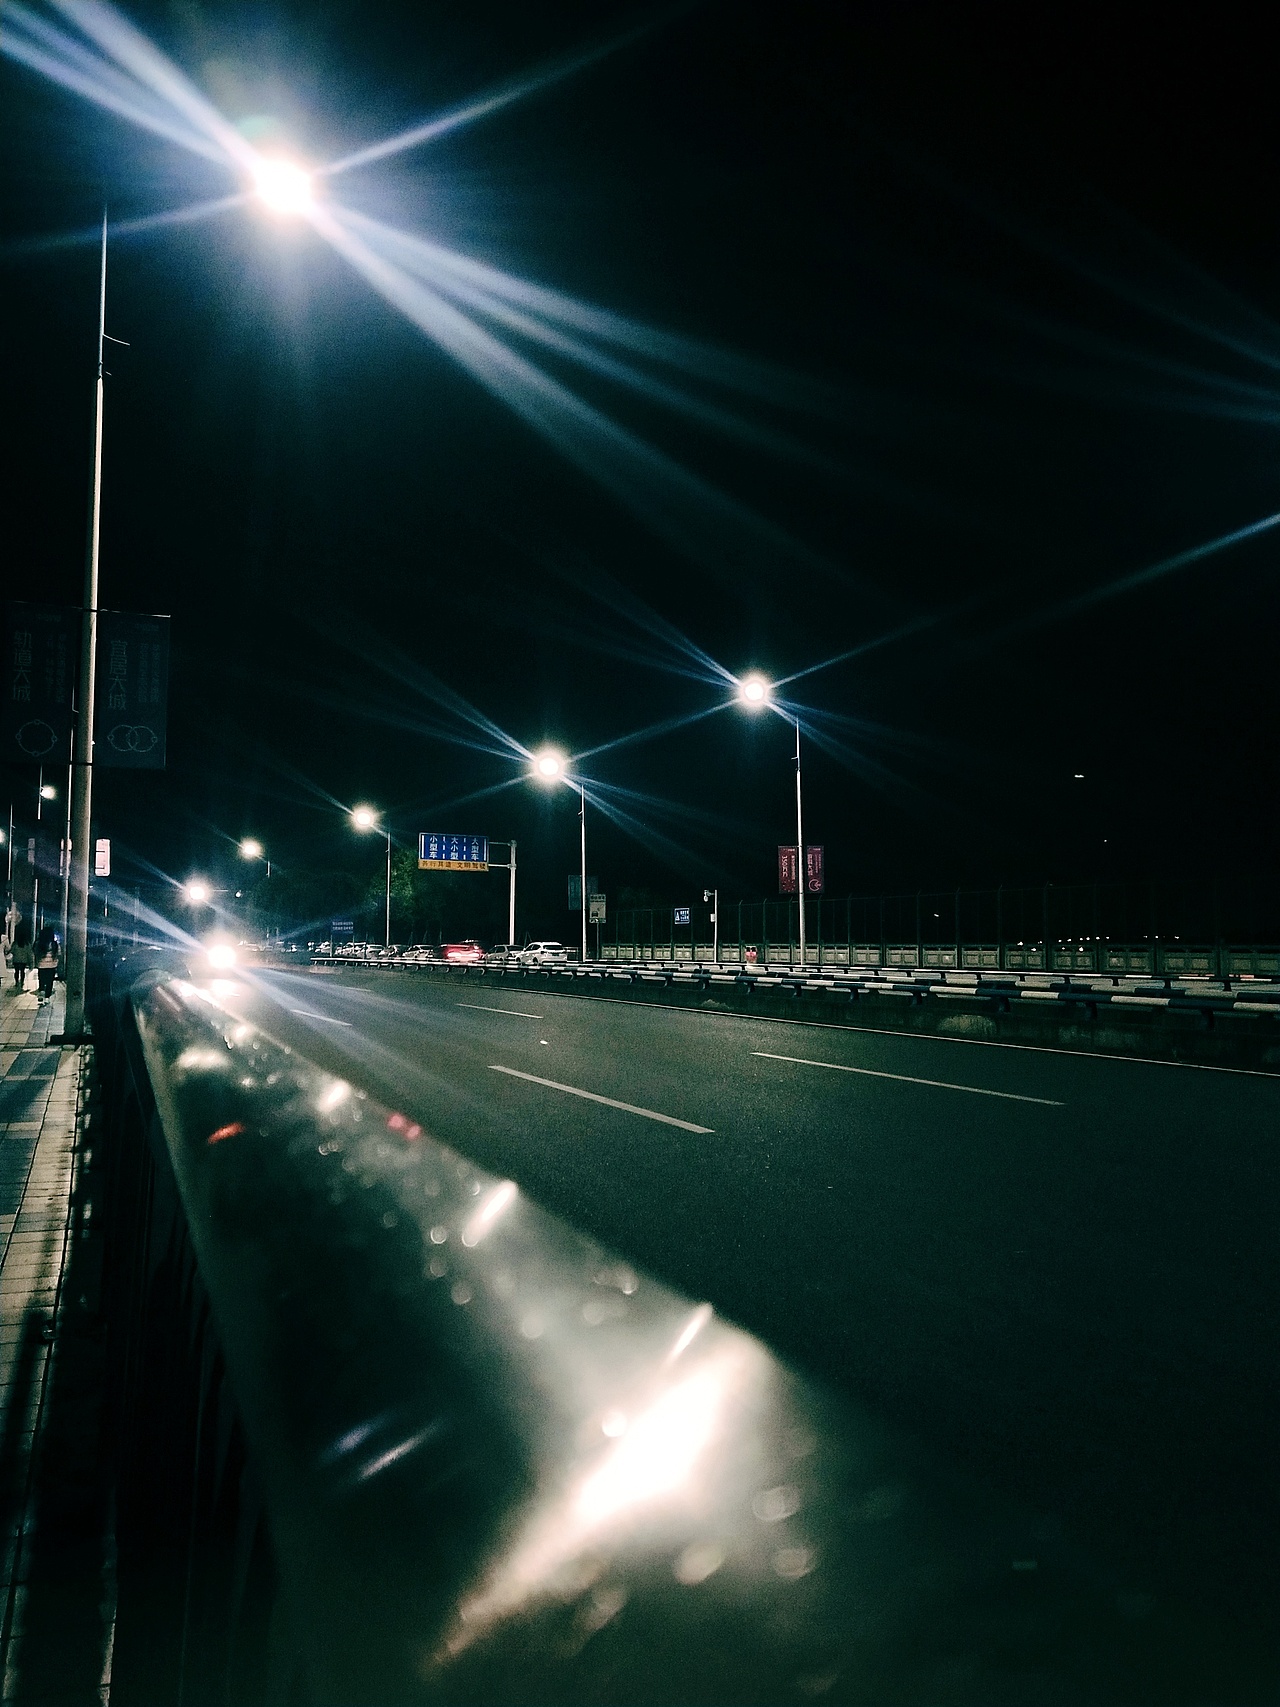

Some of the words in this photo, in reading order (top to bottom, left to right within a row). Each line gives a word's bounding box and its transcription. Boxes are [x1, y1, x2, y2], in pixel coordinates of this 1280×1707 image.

[108, 640, 128, 711] 宜居大城
[429, 835, 438, 859] 小型车
[471, 838, 479, 861] 大型车
